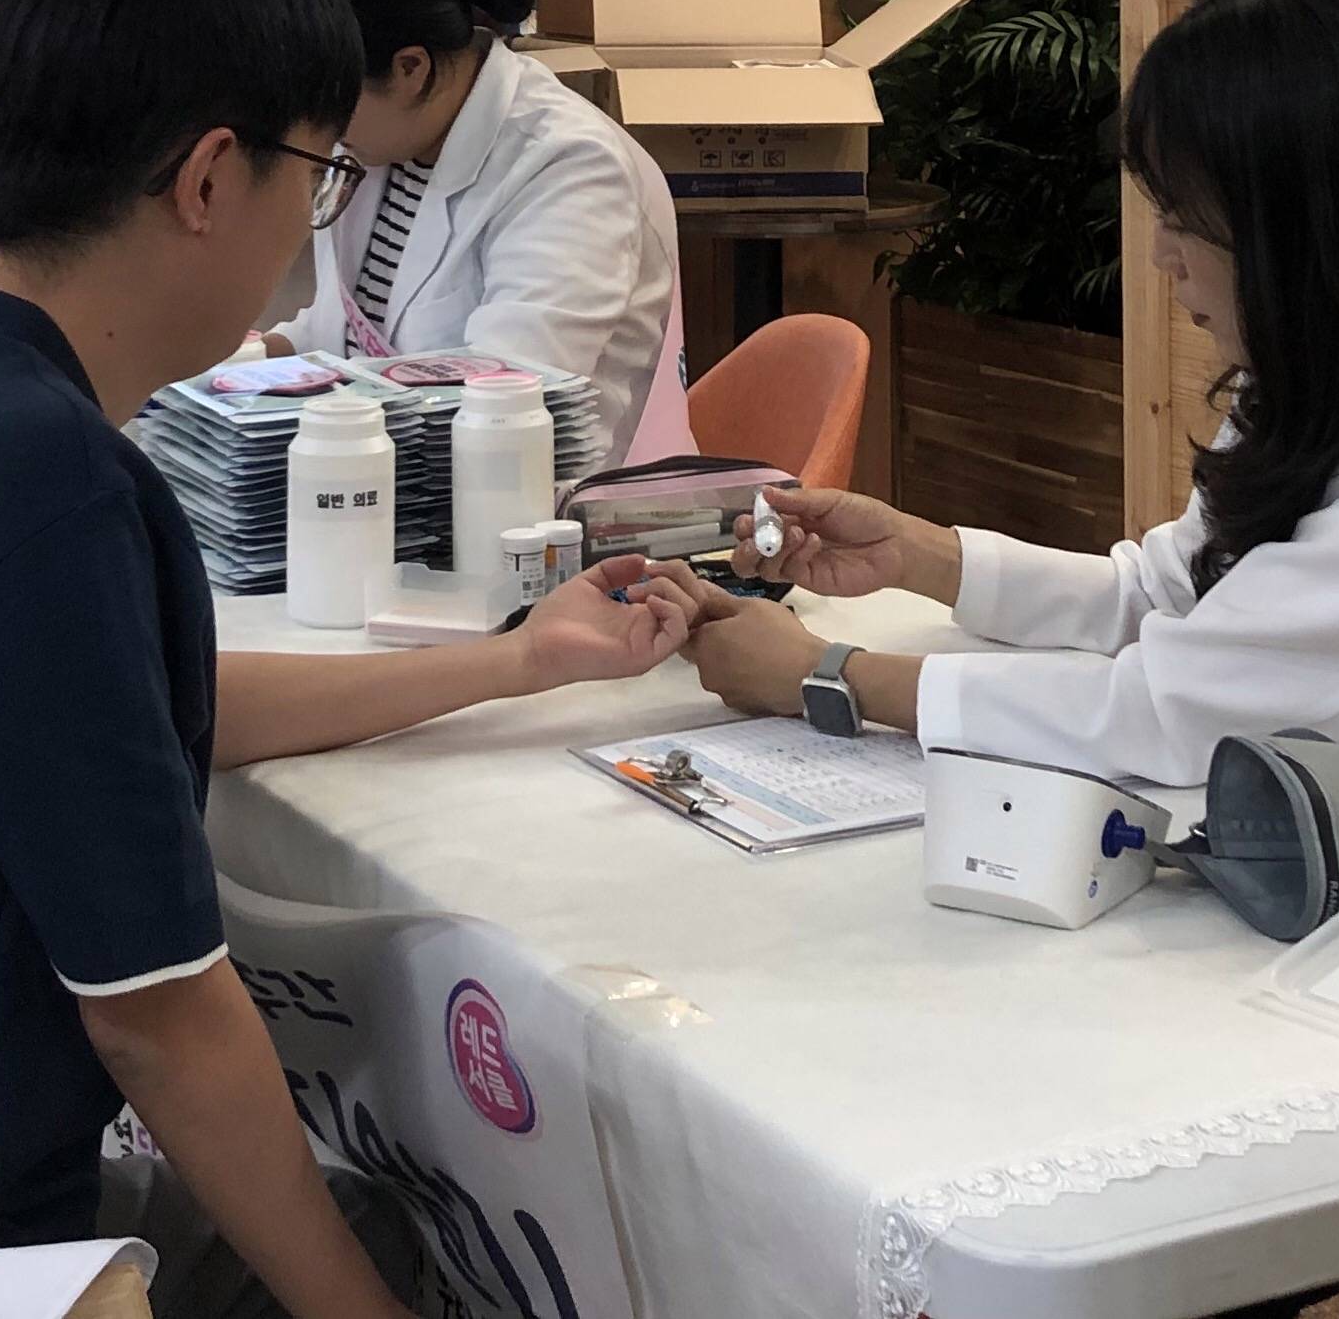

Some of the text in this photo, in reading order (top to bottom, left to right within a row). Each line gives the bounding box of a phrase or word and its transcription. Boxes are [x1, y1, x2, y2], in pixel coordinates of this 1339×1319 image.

[316, 489, 378, 509] 일반 의료
[459, 1010, 502, 1070] 레드
[468, 1057, 519, 1112] 서클
